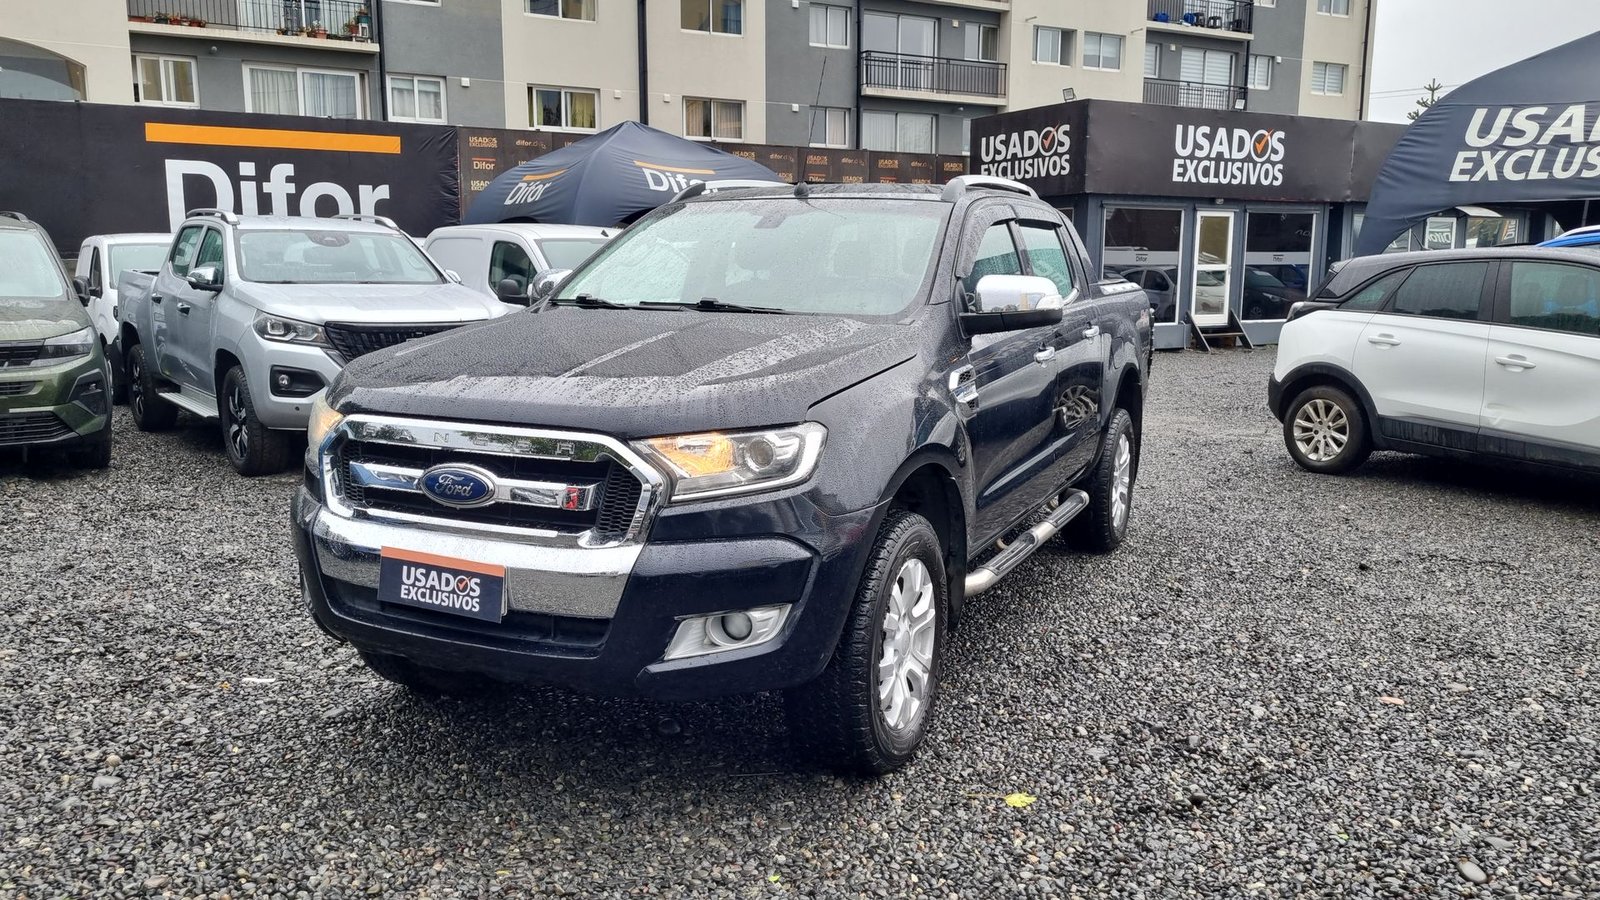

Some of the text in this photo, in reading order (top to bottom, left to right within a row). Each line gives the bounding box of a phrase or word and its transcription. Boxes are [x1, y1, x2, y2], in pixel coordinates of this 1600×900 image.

[1464, 104, 1600, 148] USA
[981, 124, 1070, 162] USADOS
[1174, 124, 1286, 162] USADOS
[473, 161, 495, 170] Difor
[1172, 158, 1284, 187] EXCLUSIVOS
[165, 158, 390, 232] Difor
[504, 181, 551, 205] Difor
[435, 473, 474, 497] Ford
[402, 565, 480, 597] USADOS
[400, 585, 480, 612] EXCLUSIVOS
